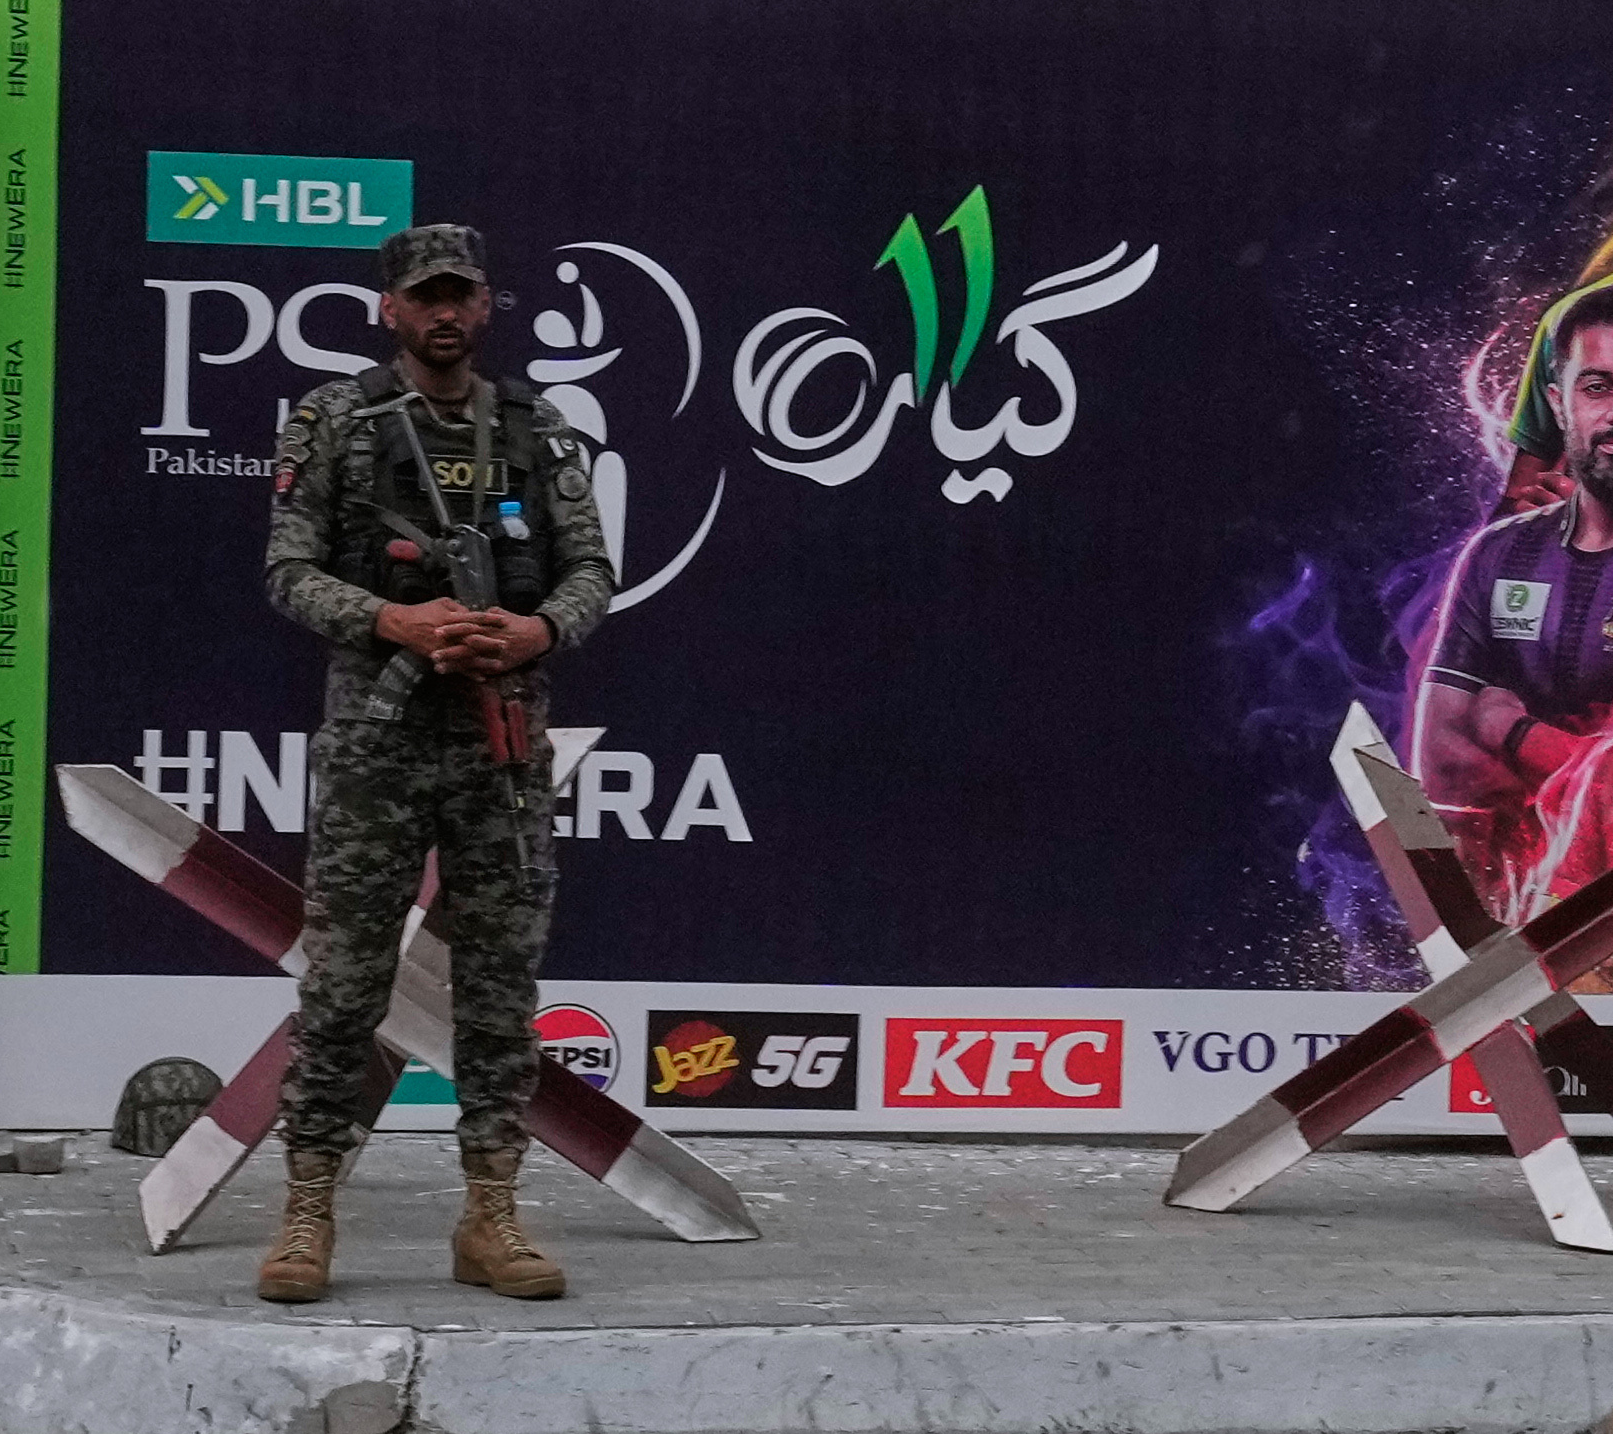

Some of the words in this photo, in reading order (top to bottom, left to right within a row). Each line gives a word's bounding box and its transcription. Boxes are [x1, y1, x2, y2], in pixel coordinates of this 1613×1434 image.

[242, 178, 388, 226] HBL
[140, 277, 382, 437] PS
[651, 1034, 739, 1094] Jazz
[751, 1034, 850, 1090] 5G
[899, 1030, 1106, 1097] KFC
[1151, 1031, 1277, 1073] VGO
